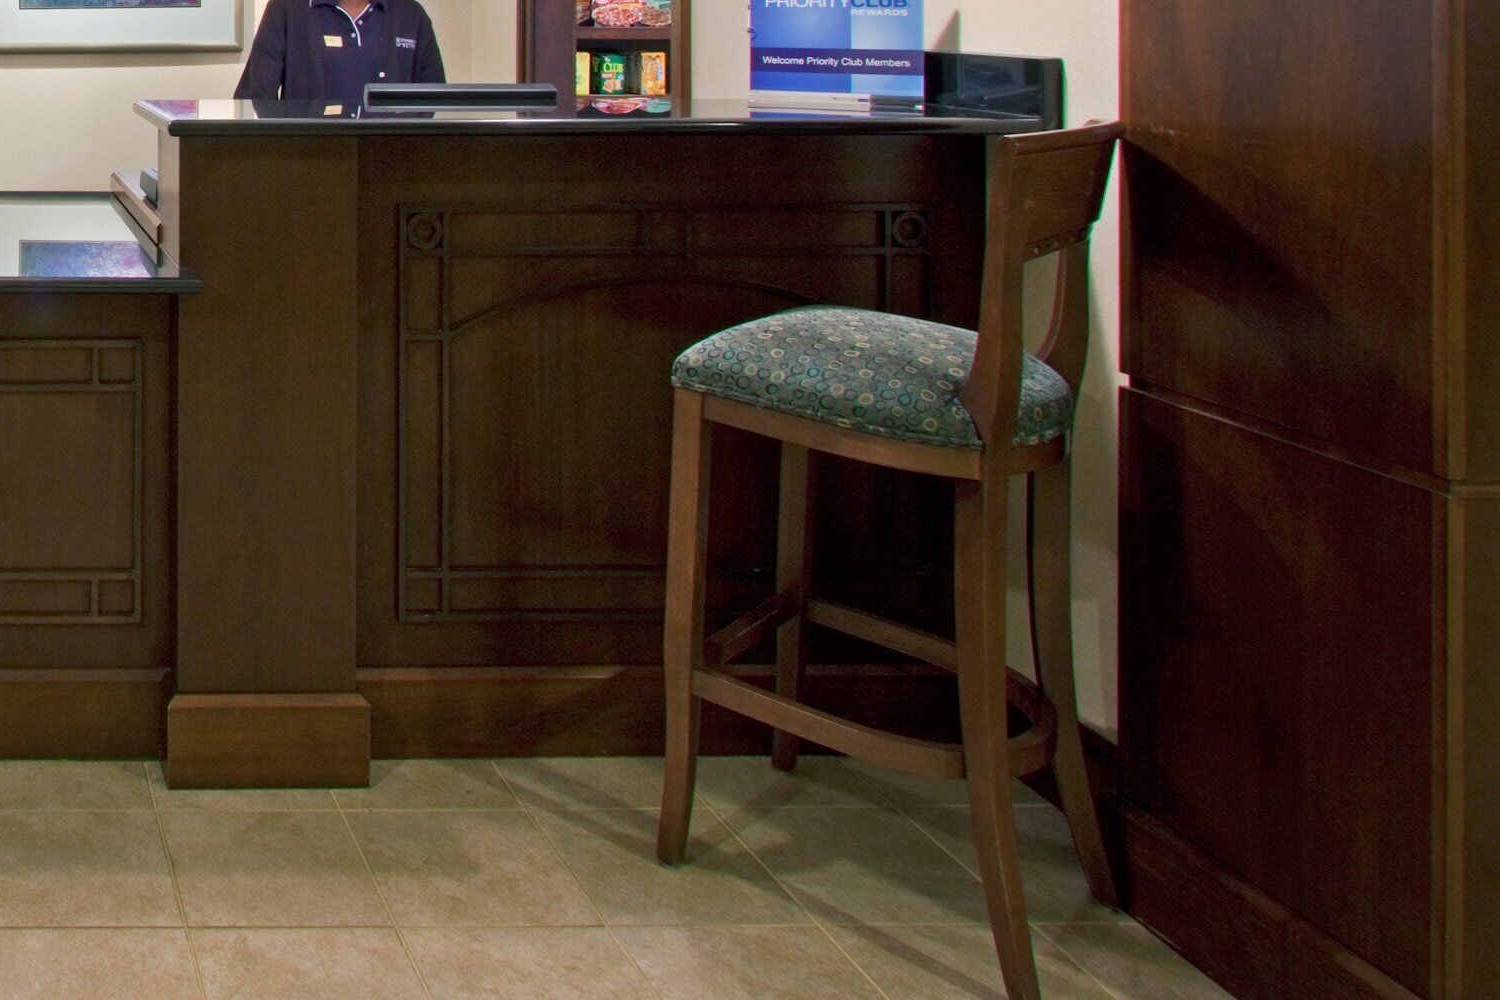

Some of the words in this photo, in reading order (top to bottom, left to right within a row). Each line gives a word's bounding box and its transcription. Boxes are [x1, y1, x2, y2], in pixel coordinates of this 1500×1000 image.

[850, 9, 908, 17] REWARDS
[603, 62, 623, 73] CLUB
[762, 56, 804, 65] Welcome
[806, 56, 839, 68] Priority
[841, 57, 862, 66] Club
[865, 58, 910, 68] Members
